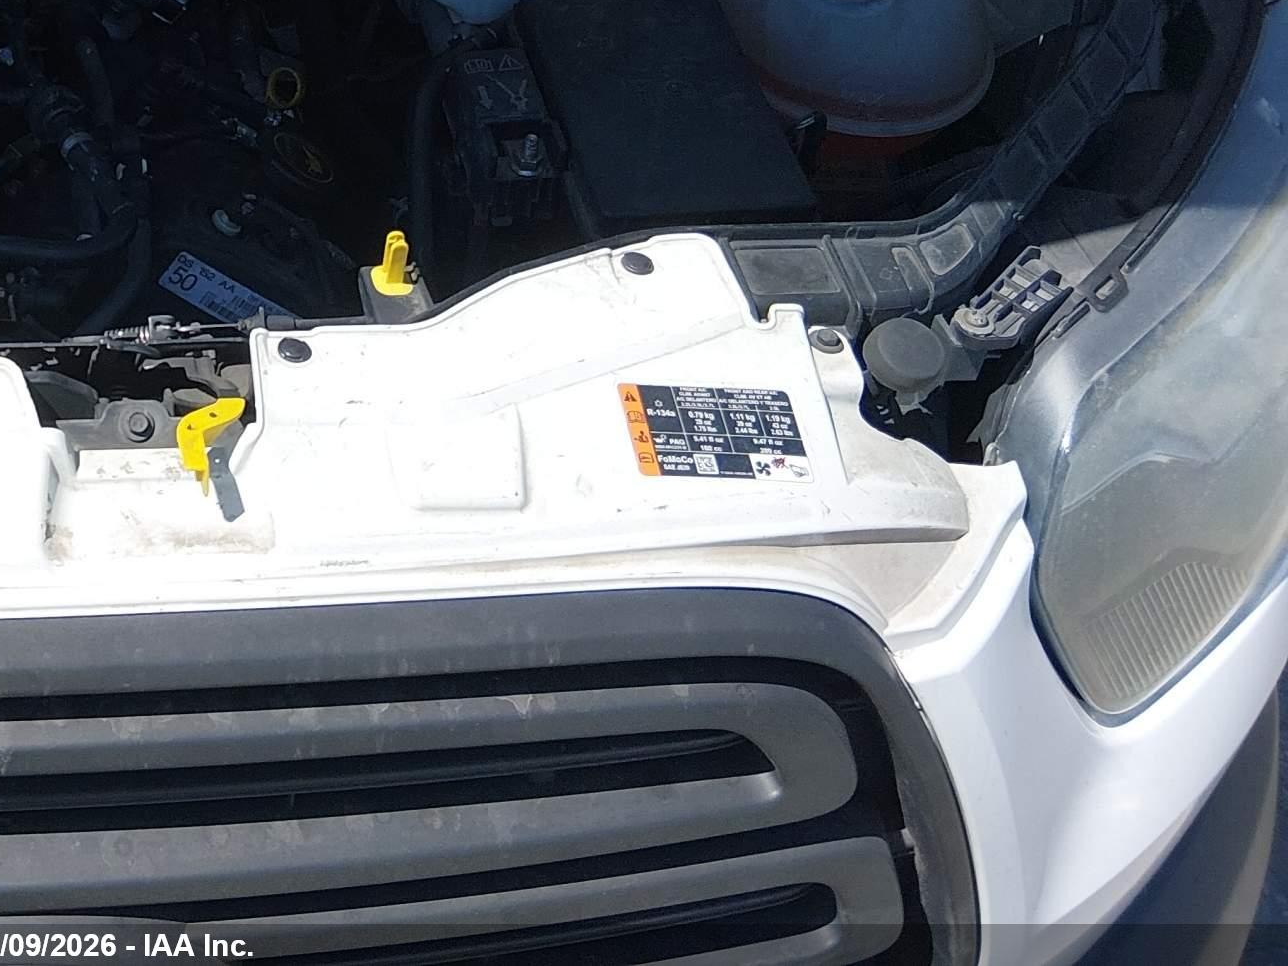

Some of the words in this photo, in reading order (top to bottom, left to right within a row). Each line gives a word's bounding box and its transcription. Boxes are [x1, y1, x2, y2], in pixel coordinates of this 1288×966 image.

[168, 266, 198, 291] 50
[646, 408, 677, 417] R-134a
[688, 411, 703, 419] 0.79
[704, 412, 715, 421] kg
[730, 412, 744, 420] 1.11
[745, 413, 756, 422] kg
[765, 414, 780, 422] 1.19
[780, 415, 791, 424] kg
[657, 455, 693, 464] FoMoCo
